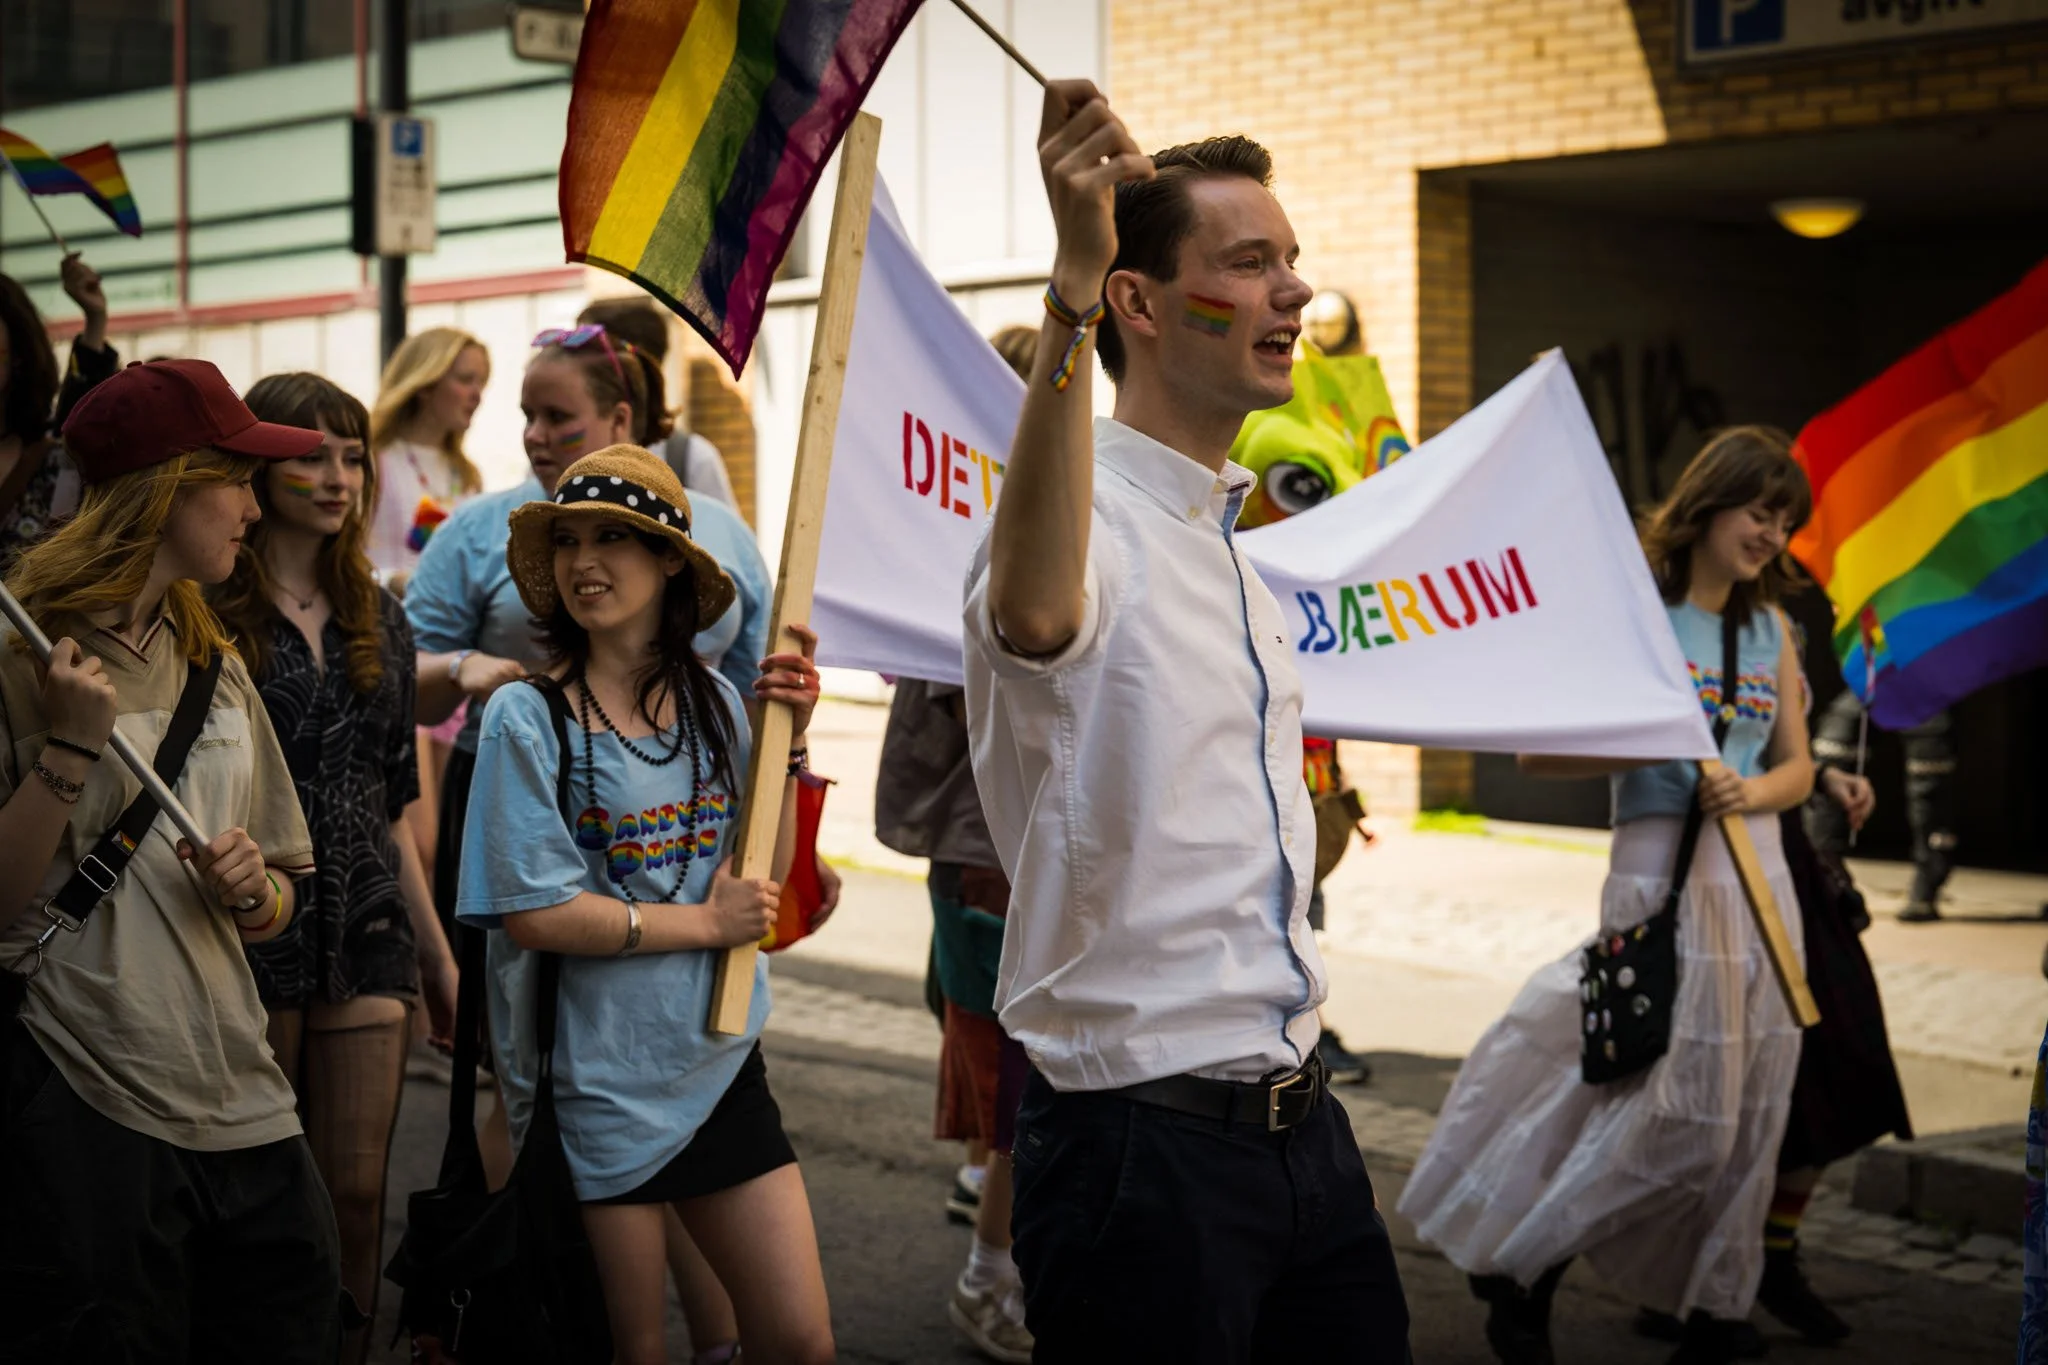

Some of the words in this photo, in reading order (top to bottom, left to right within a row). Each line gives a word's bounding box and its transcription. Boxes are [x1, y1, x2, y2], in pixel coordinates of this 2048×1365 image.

[903, 410, 1005, 519] DET
[1296, 546, 1538, 654] BÆRUM
[607, 828, 718, 884] PRIDE
